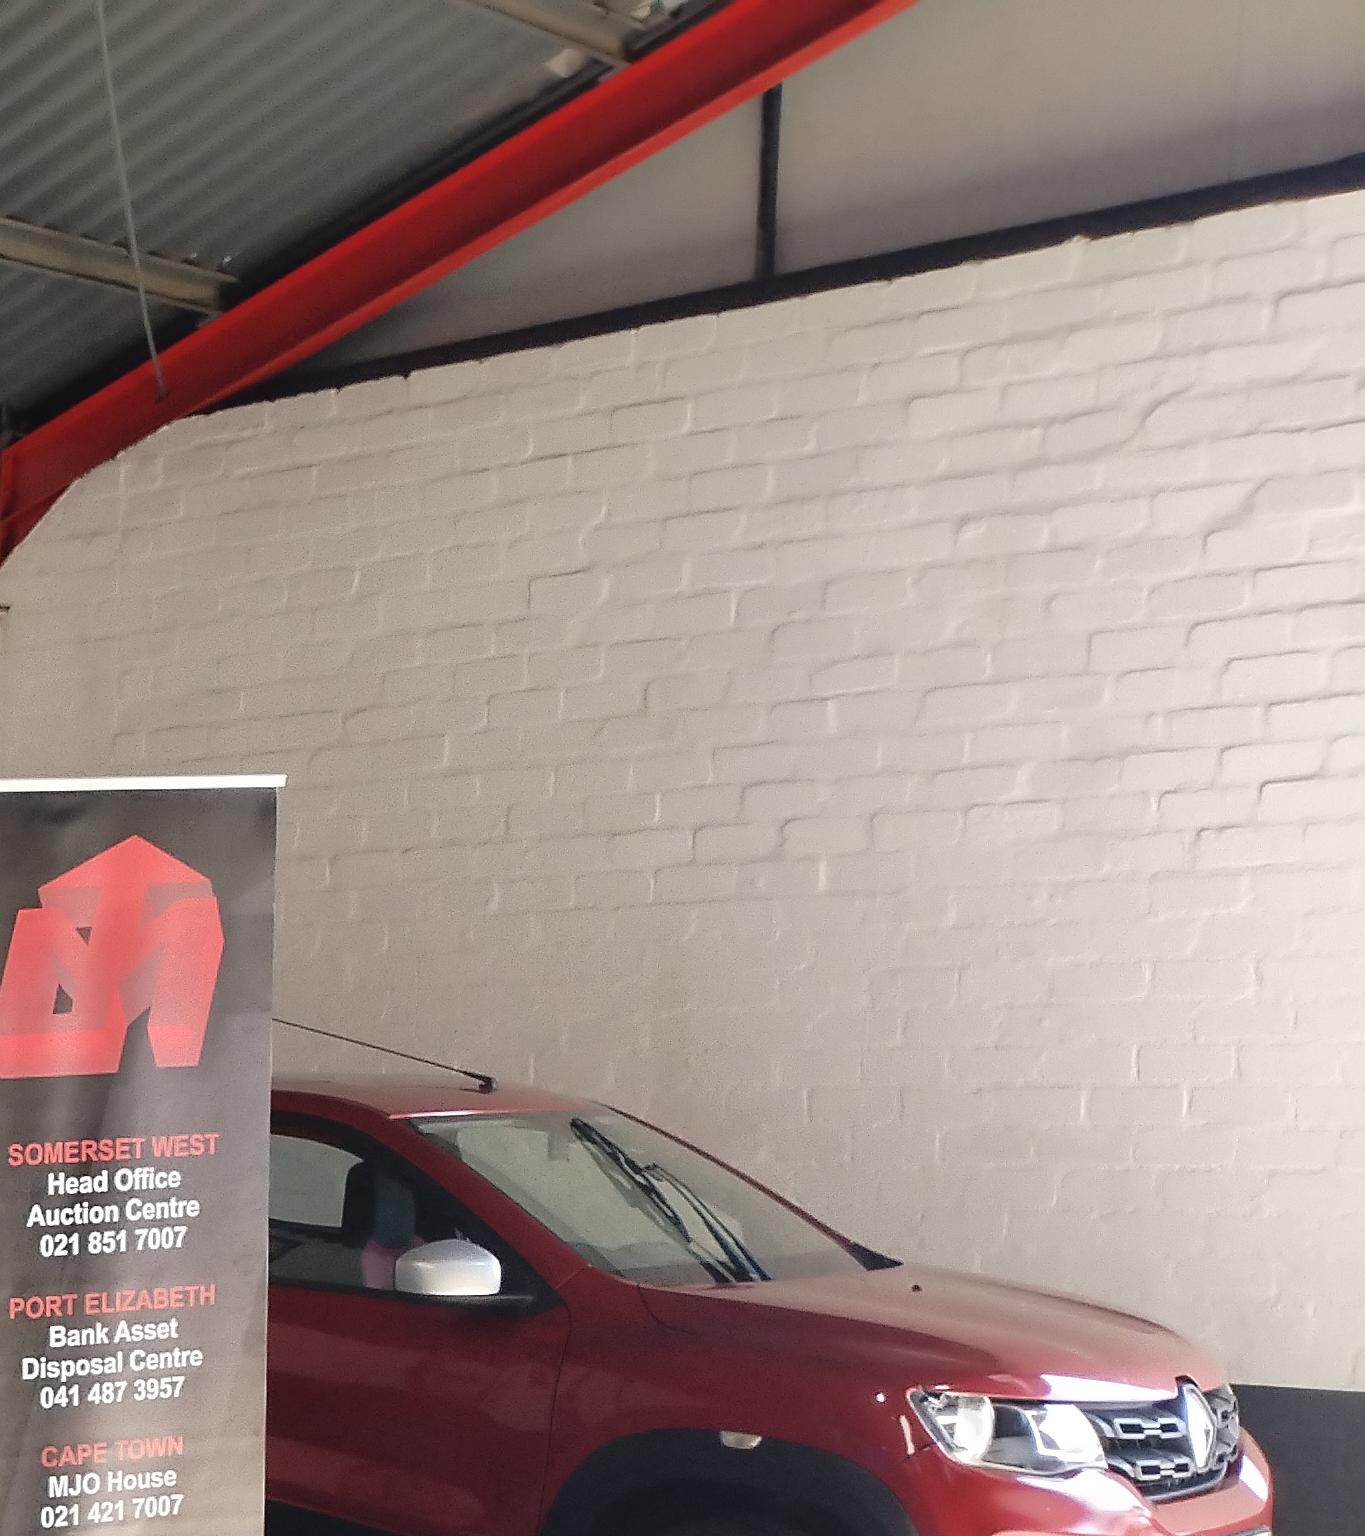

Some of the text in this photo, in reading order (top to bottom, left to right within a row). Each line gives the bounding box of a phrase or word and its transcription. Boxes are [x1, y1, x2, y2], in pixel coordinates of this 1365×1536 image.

[8, 1132, 220, 1167] SOMERSET WEST
[48, 1166, 182, 1195] Head Office
[27, 1196, 200, 1227] Auction Centre
[40, 1225, 188, 1257] 021 851 7007
[9, 1284, 216, 1319] PORT ELIZABETH
[49, 1317, 178, 1347] Bank Asset
[22, 1347, 203, 1382] Disposal Centre
[40, 1376, 184, 1409] 041 487 3957
[41, 1435, 184, 1468] CAPE TOWN
[48, 1469, 177, 1499] MJO House
[41, 1494, 183, 1528] 021 421 7007
